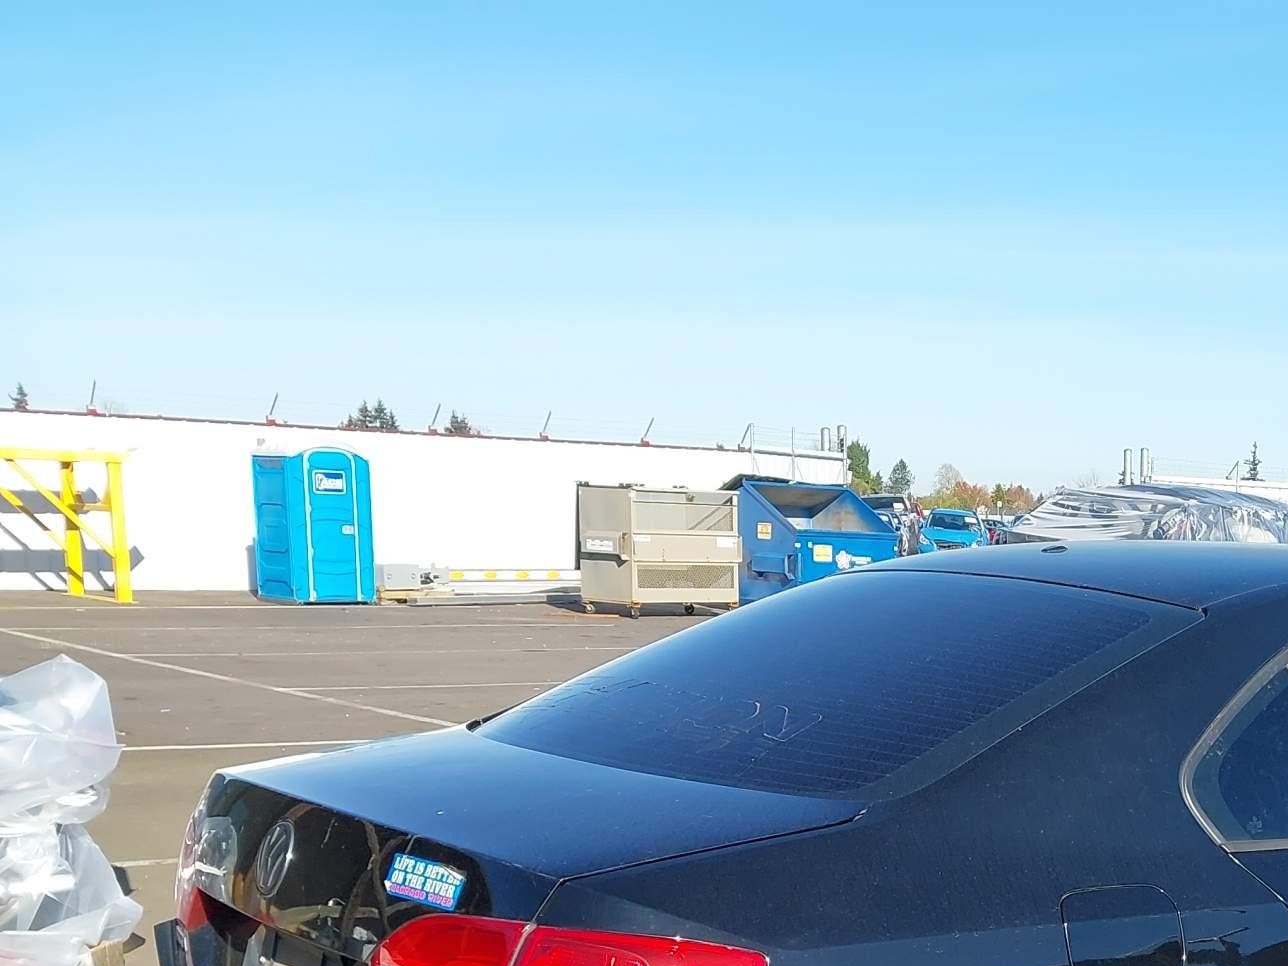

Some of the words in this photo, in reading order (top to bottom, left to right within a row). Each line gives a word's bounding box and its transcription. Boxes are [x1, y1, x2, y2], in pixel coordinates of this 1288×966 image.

[394, 856, 416, 874] LIFE
[414, 861, 426, 875] IS
[391, 870, 406, 885] ON
[405, 873, 425, 889] THE
[424, 878, 456, 898] RIVER
